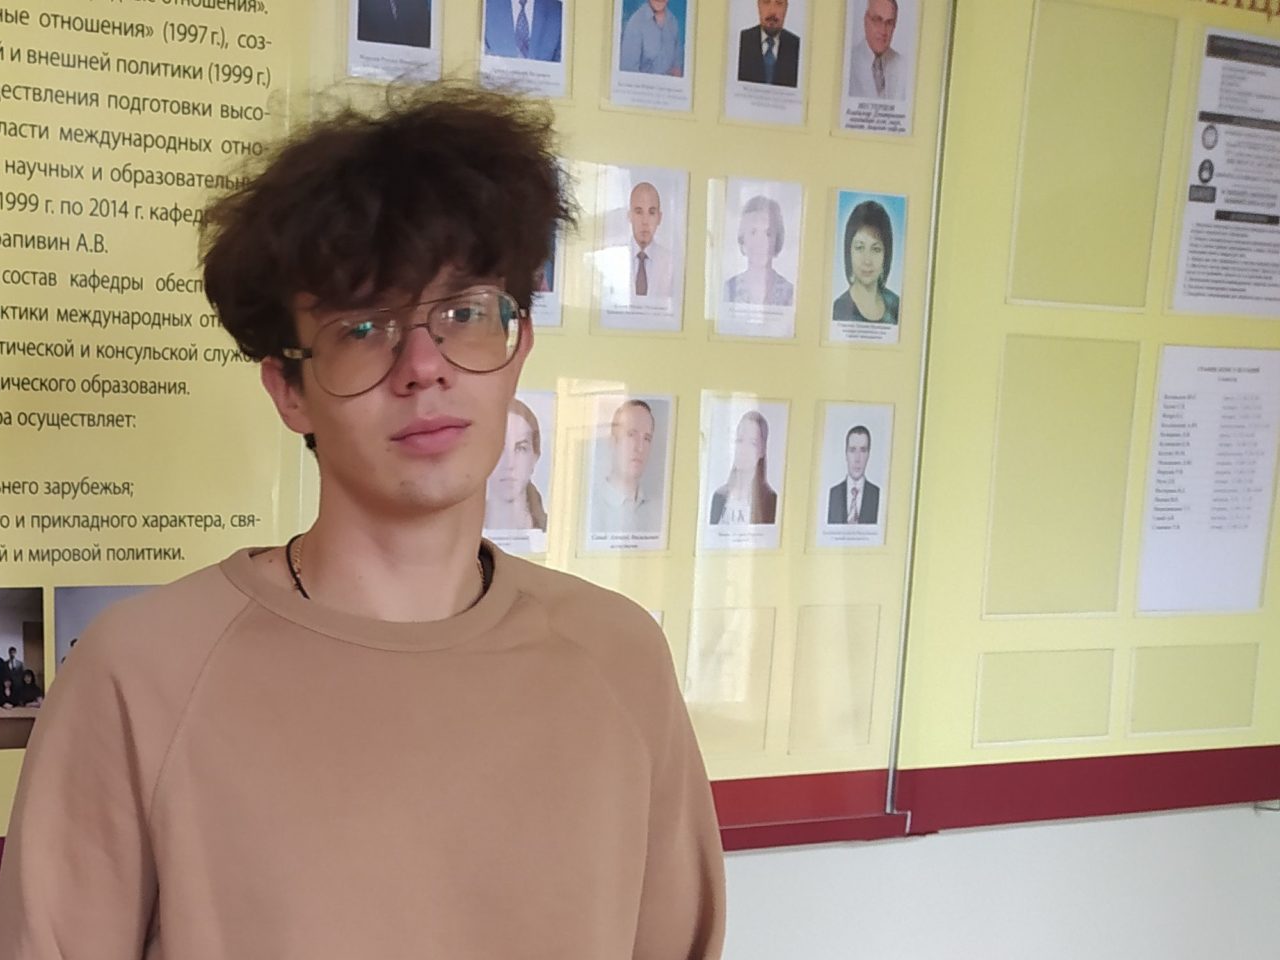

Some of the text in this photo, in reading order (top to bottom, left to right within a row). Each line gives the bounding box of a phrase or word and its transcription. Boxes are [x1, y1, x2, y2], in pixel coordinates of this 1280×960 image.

[39, 12, 154, 38] отношения»
[237, 33, 271, 50] соз-
[10, 47, 21, 63] и
[27, 48, 110, 71] внешней
[116, 58, 203, 80] политики
[208, 62, 253, 84] (1999
[107, 94, 212, 117] подготовки
[220, 103, 270, 121] высо-
[59, 126, 212, 154] международных
[5, 159, 84, 181] научных
[92, 166, 102, 181] и
[45, 199, 54, 214] г.
[60, 200, 83, 216] по
[89, 197, 129, 219] 2014
[135, 205, 144, 220] г.
[150, 202, 210, 227] кафед
[76, 233, 108, 253] А.В.
[2, 269, 57, 287] состав
[70, 268, 143, 295] кафедры
[156, 273, 203, 293] обесп
[56, 308, 192, 330] международных
[80, 343, 90, 358] и
[96, 343, 198, 365] консульской
[80, 373, 190, 399] образования.
[17, 411, 136, 432] осуществляет:
[43, 476, 134, 500] зарубежья;
[15, 515, 25, 528] и
[31, 514, 137, 533] прикладного
[142, 514, 225, 532] характера,
[230, 514, 261, 527] свя-
[13, 548, 23, 562] и
[28, 543, 101, 566] мировой
[106, 547, 185, 561] политики.
